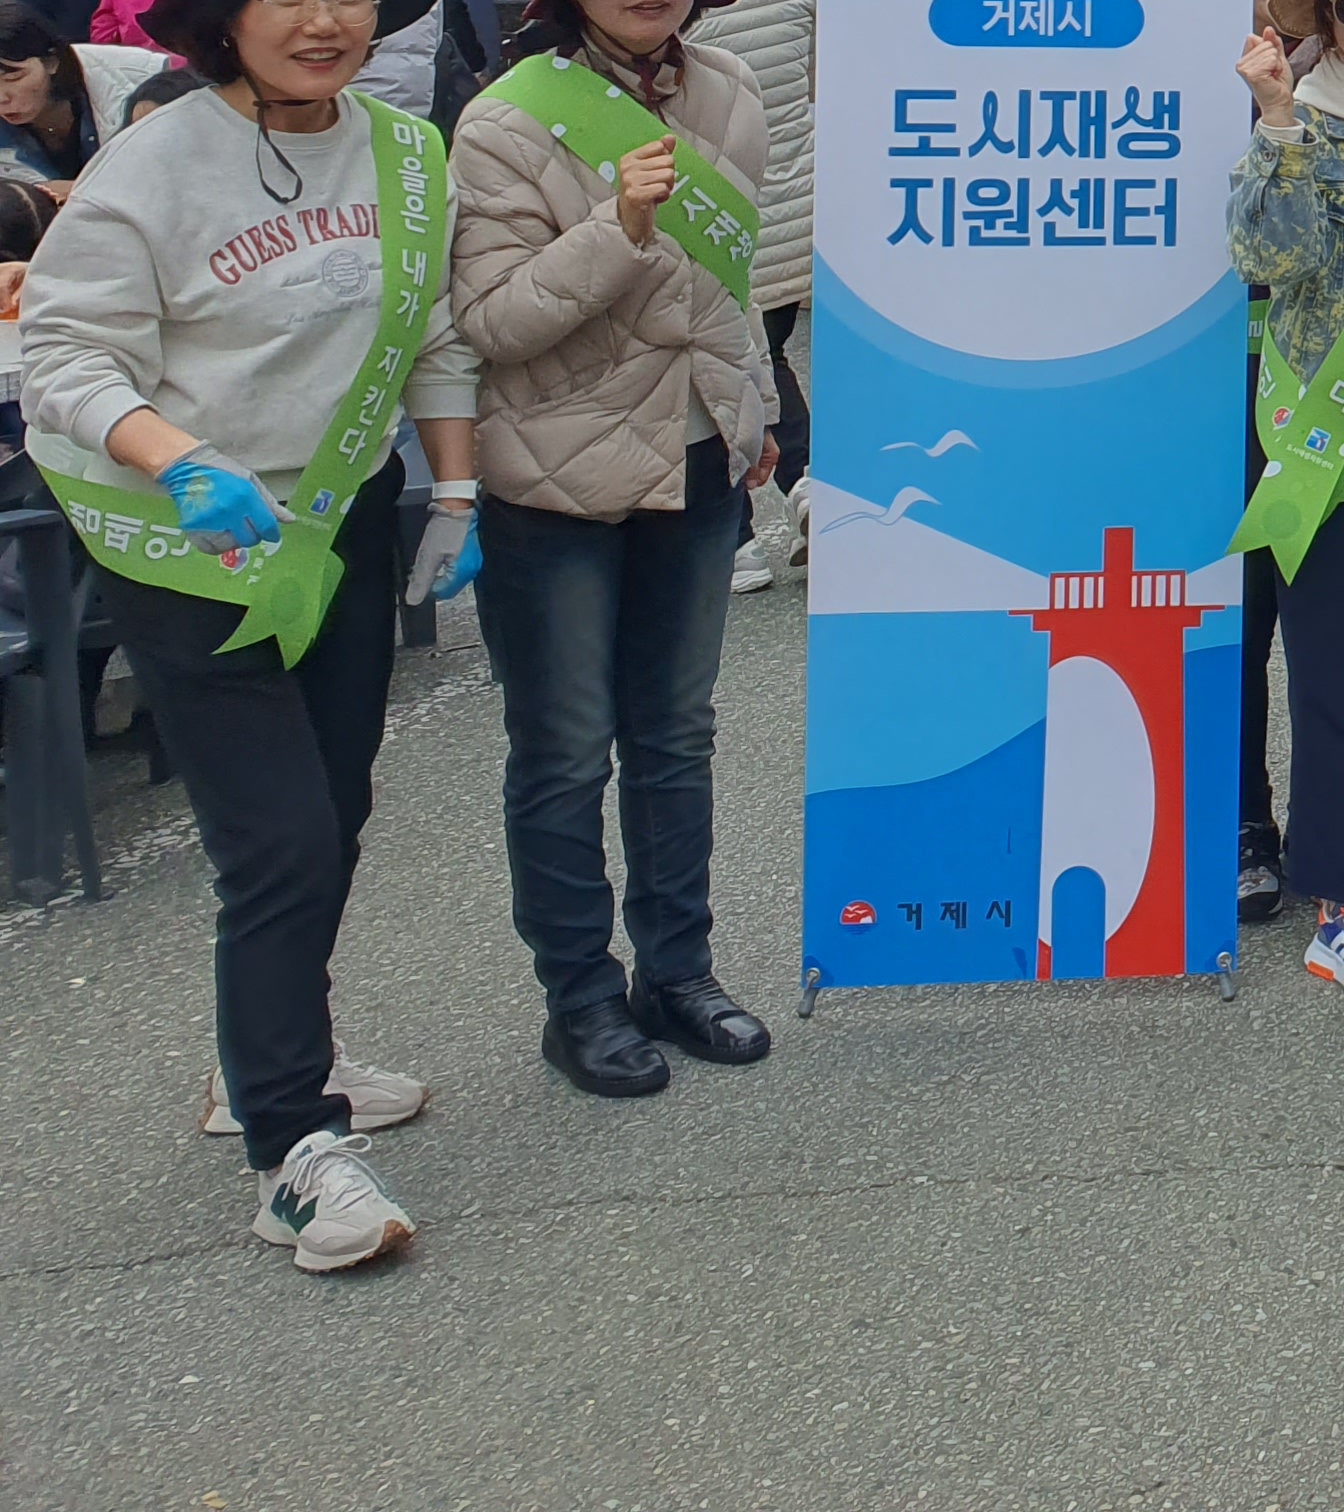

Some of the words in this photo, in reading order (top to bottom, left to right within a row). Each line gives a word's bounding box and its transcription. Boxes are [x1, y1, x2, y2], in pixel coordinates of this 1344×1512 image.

[886, 85, 1182, 161] 도시재생
[392, 108, 431, 235] 마을은
[886, 176, 1178, 248] 지원센터
[208, 213, 299, 286] GUESS
[671, 171, 754, 262] 시재생
[396, 248, 428, 329] 내가
[338, 345, 403, 466] 지킨다
